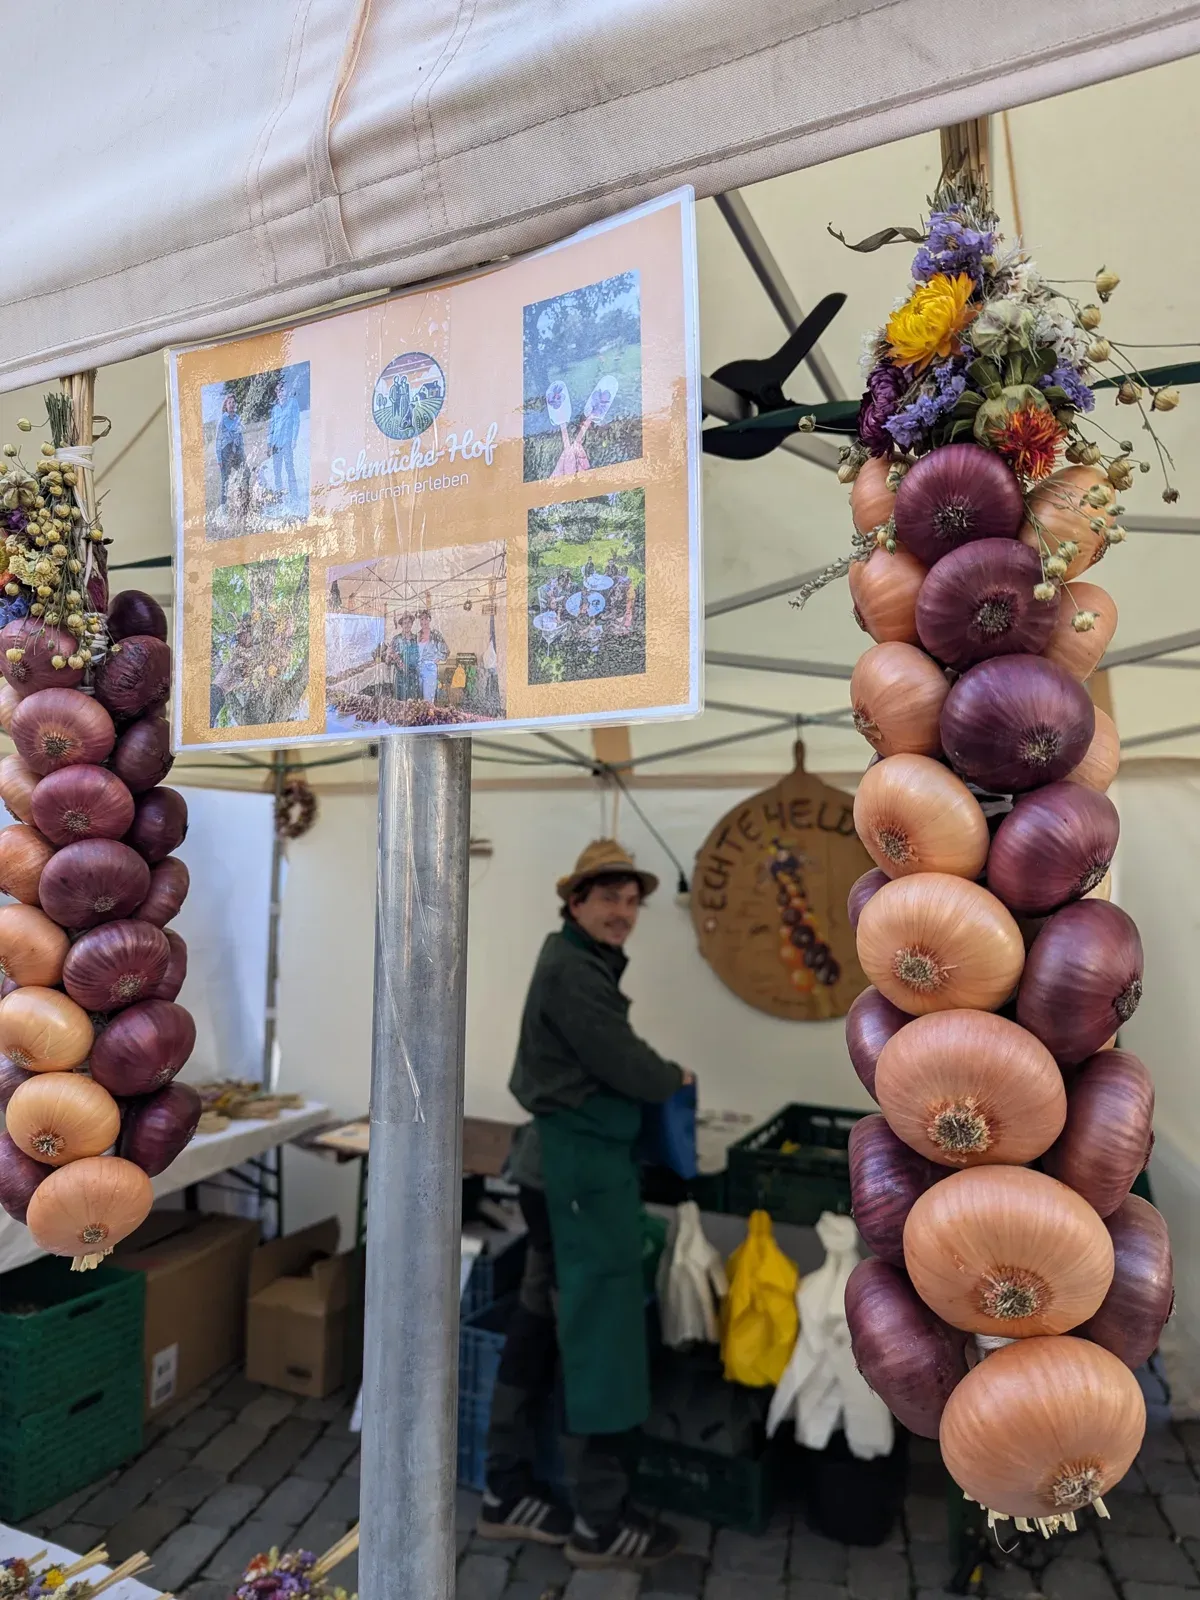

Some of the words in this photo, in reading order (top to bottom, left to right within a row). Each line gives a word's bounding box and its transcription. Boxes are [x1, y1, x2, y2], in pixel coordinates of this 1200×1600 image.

[328, 421, 498, 487] Schmücke-Hof
[349, 482, 410, 505] naturnah
[413, 472, 469, 494] erleben
[701, 808, 761, 911] ECHTE
[762, 798, 856, 837] HELD
